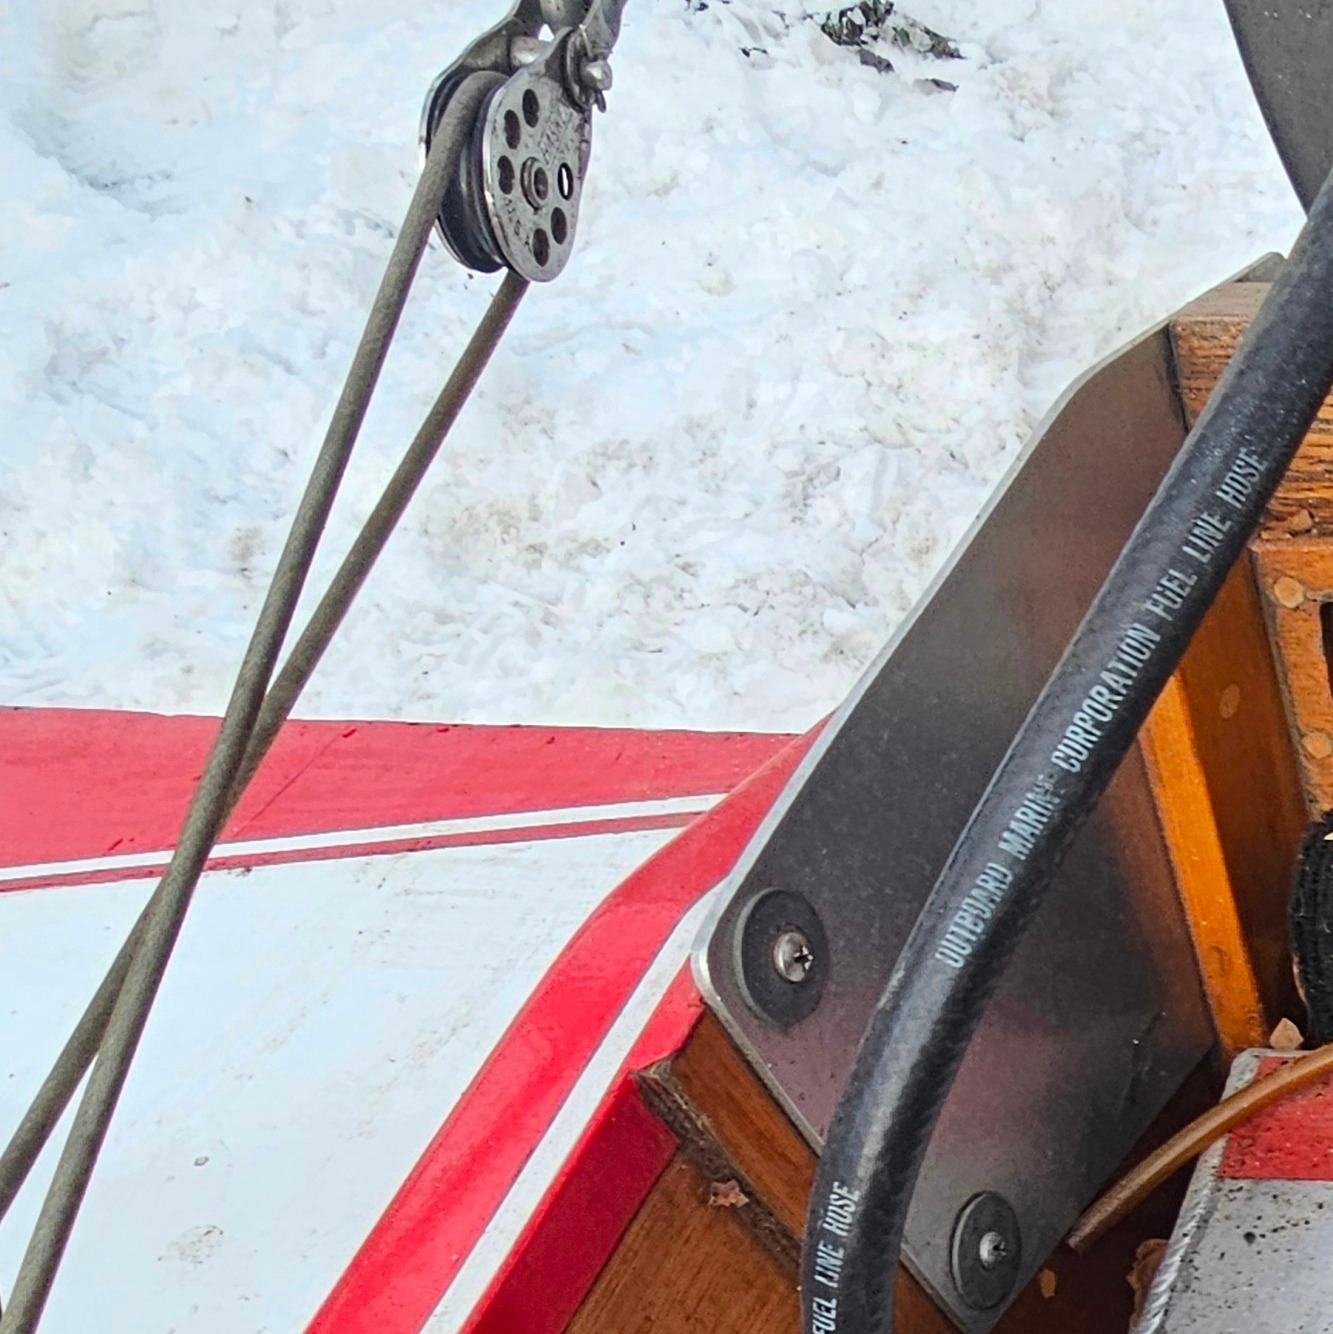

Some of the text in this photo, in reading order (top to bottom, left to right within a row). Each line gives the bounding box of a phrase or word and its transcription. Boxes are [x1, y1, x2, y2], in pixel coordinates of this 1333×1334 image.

[934, 862, 1013, 969] OUTBOARD
[1051, 623, 1162, 773] CORPORATION
[1145, 567, 1197, 622] FUEL
[1182, 510, 1232, 566] LINE
[1215, 447, 1268, 510] HOSE
[814, 1239, 845, 1290] LINE
